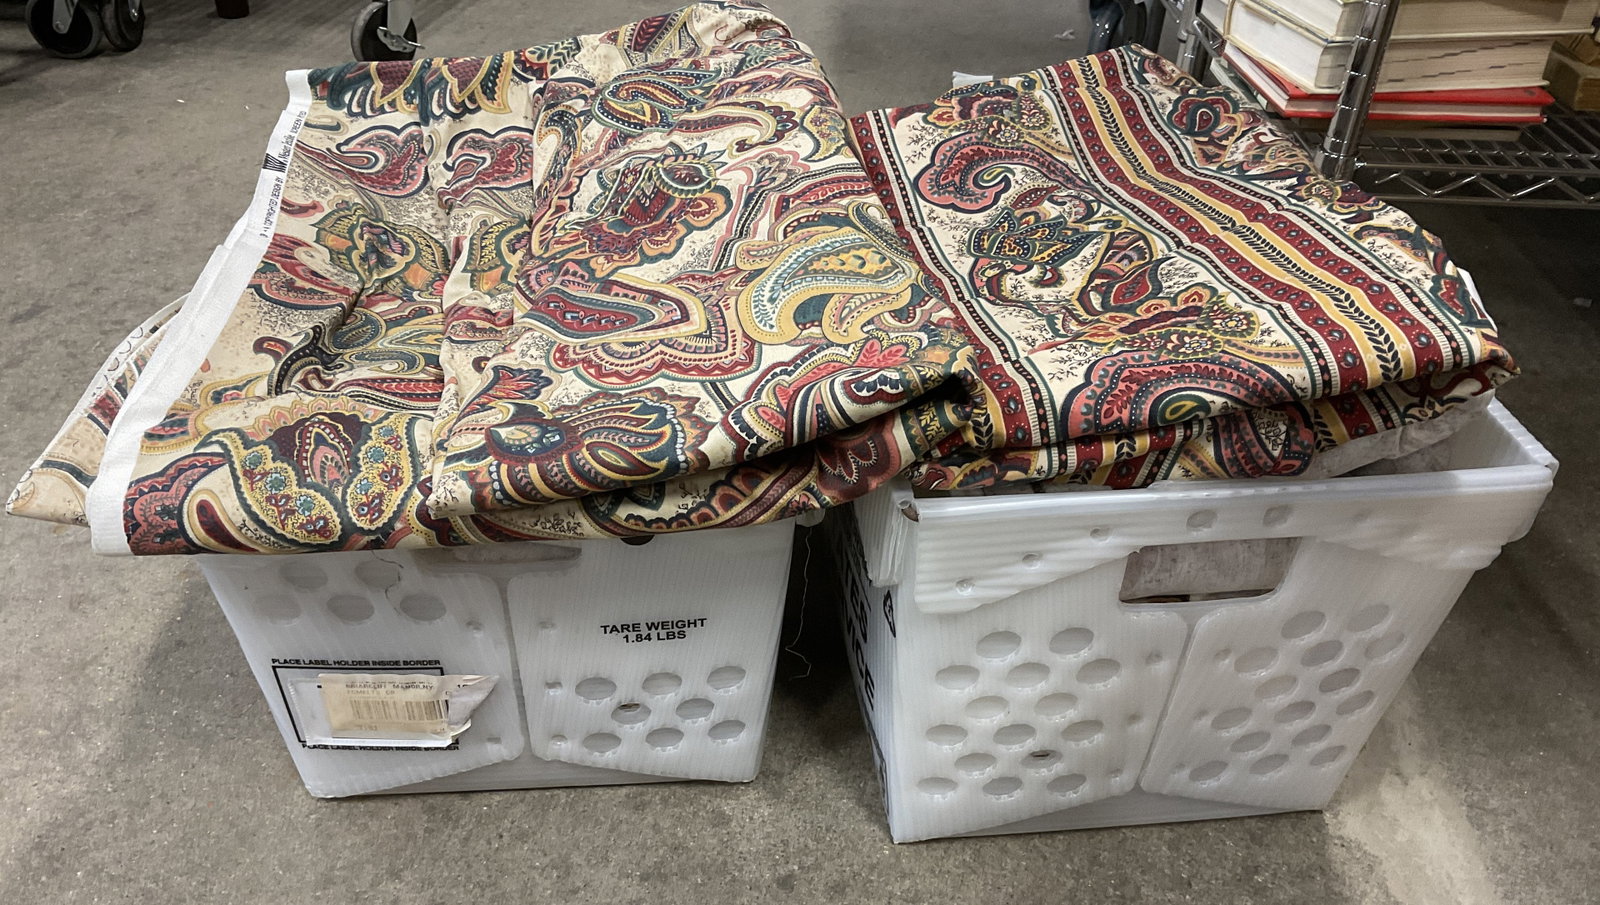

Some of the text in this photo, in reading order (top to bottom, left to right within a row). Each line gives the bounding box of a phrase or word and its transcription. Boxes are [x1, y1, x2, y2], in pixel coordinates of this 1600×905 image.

[275, 176, 284, 185] BY
[271, 183, 282, 200] DESIGN
[600, 618, 707, 634] TARE WEIGHT
[623, 630, 686, 643] 1.84 LBS
[333, 659, 370, 667] HOLDER
[403, 659, 441, 667] BORDER
